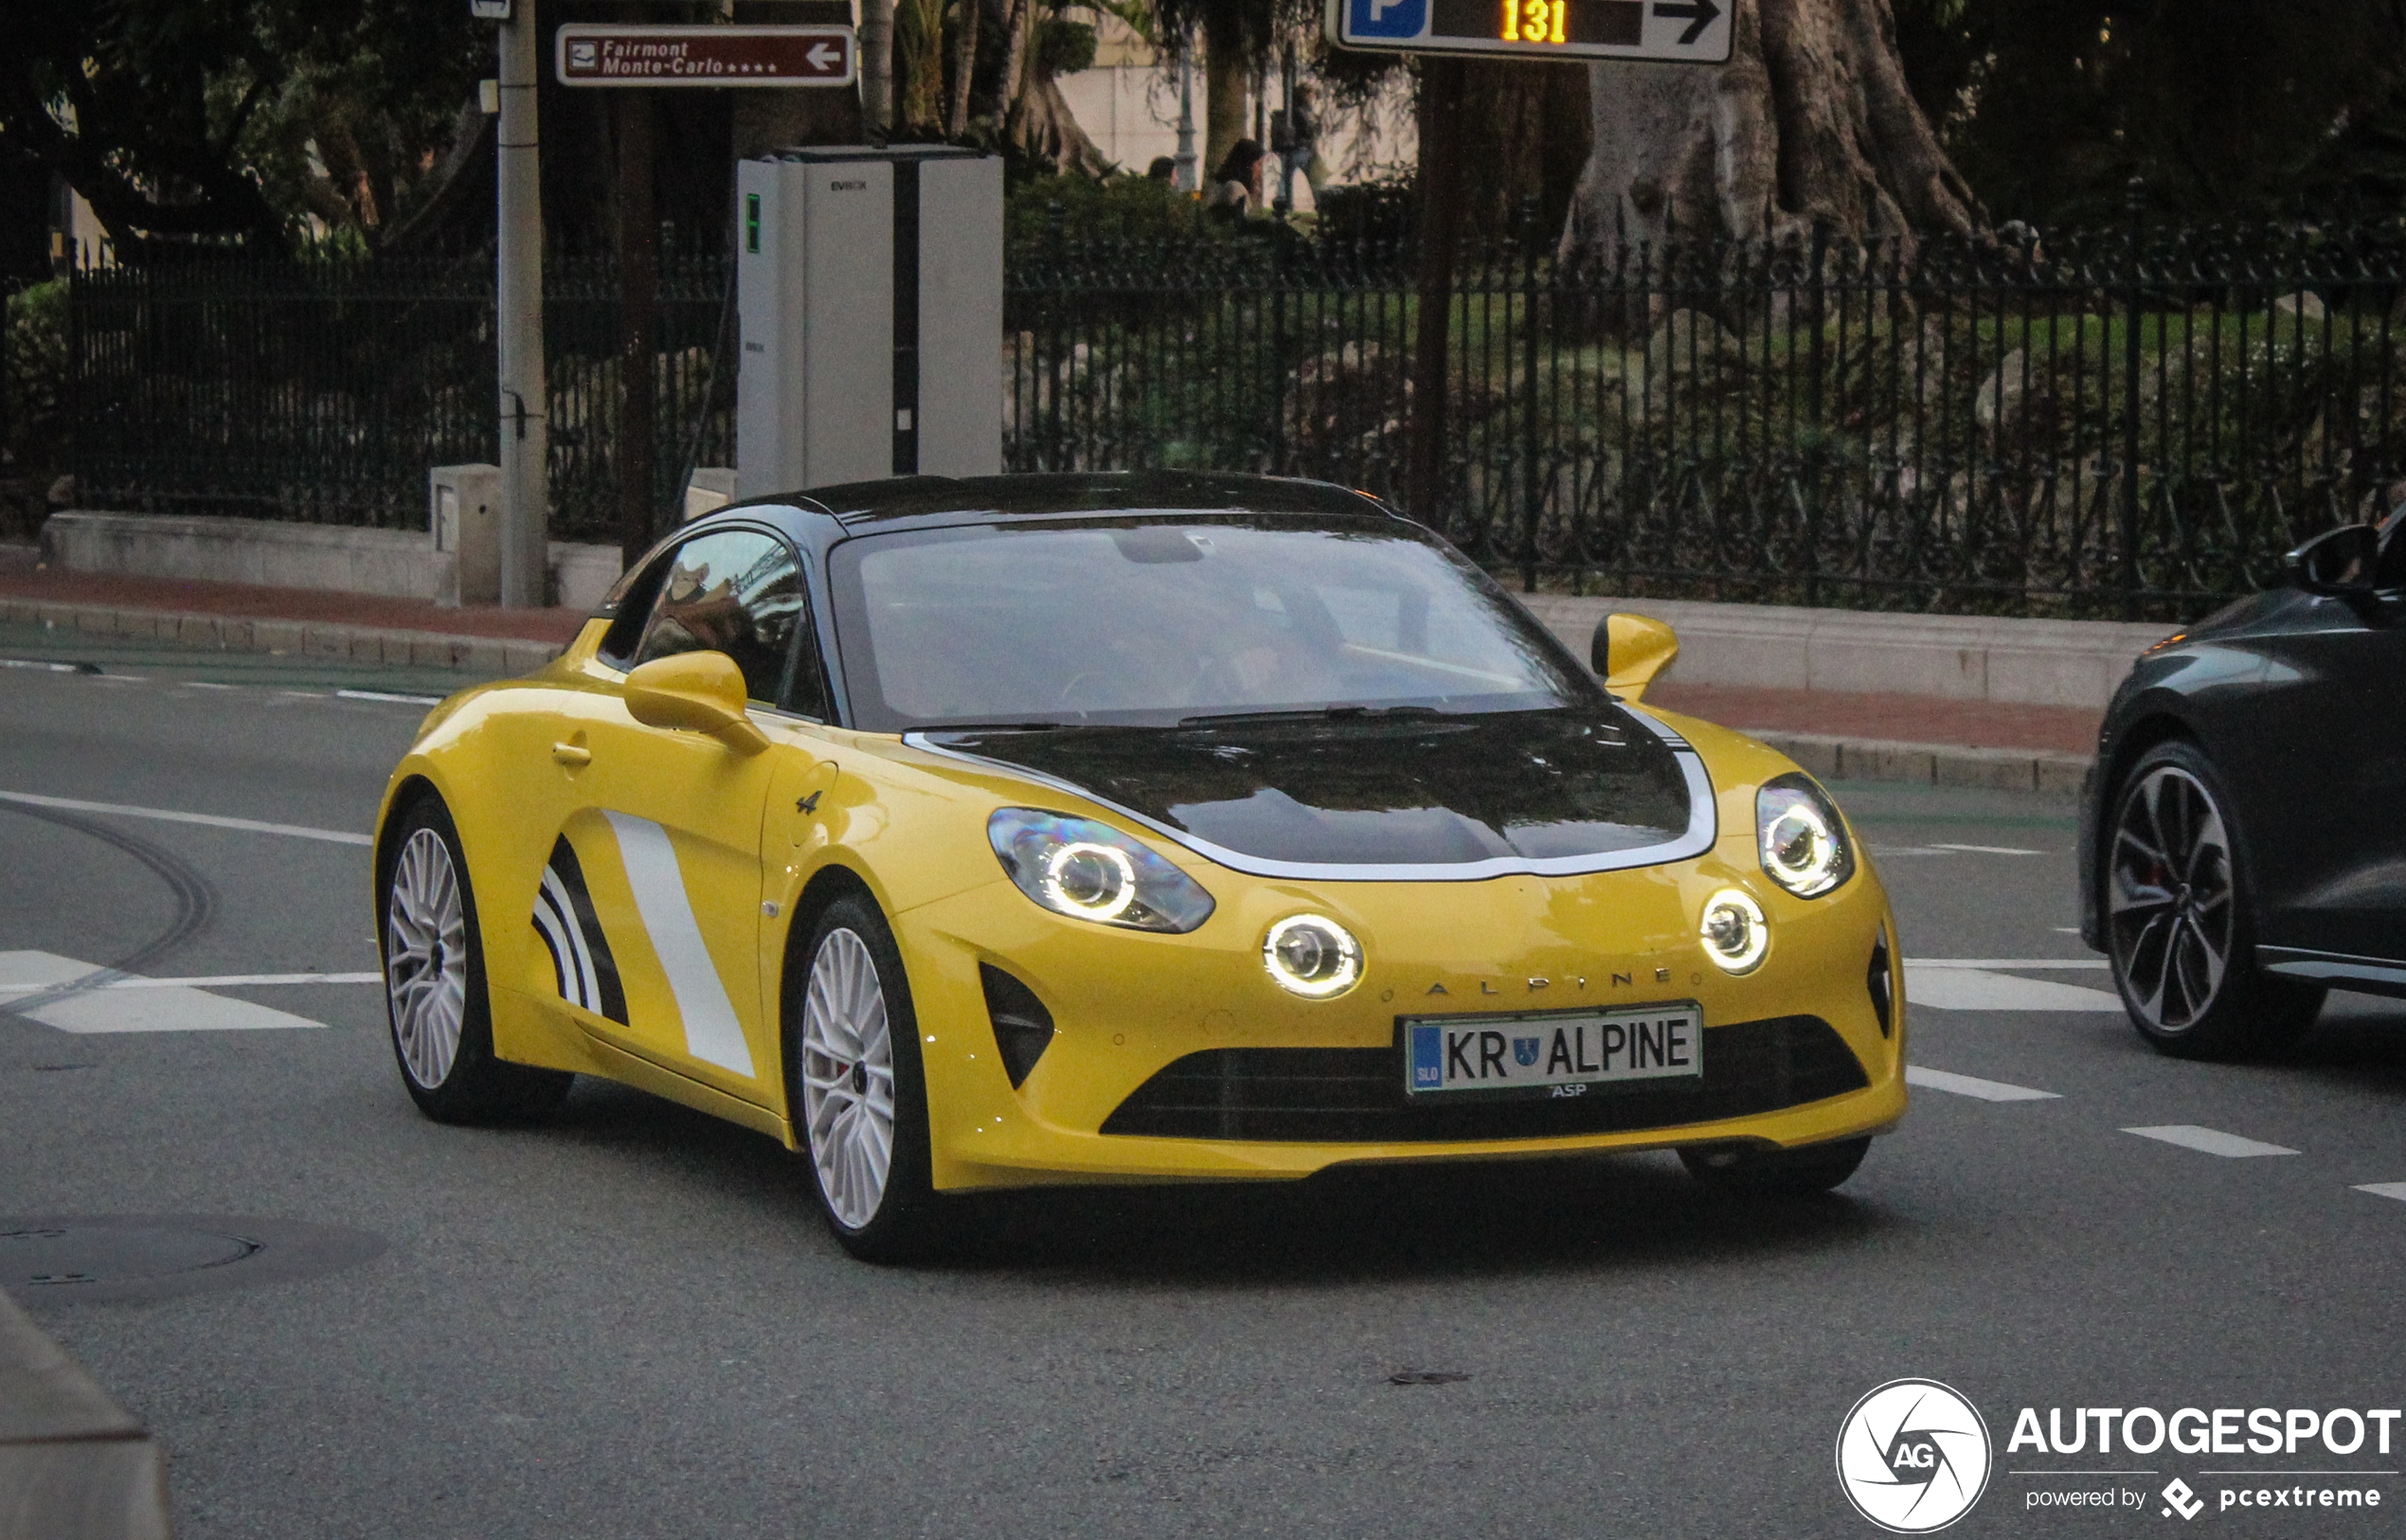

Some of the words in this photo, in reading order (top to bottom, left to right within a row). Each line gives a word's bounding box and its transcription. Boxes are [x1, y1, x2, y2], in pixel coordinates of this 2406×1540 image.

[1503, 0, 1565, 42] 131
[602, 41, 689, 57] Fairmont
[602, 58, 723, 74] Monte-Carlo
[1426, 968, 1670, 994] ALPINE
[1417, 1066, 1439, 1081] SLO
[1447, 1030, 1507, 1079] KR
[1547, 1018, 1690, 1075] ALPINE
[1552, 1084, 1588, 1098] ASP
